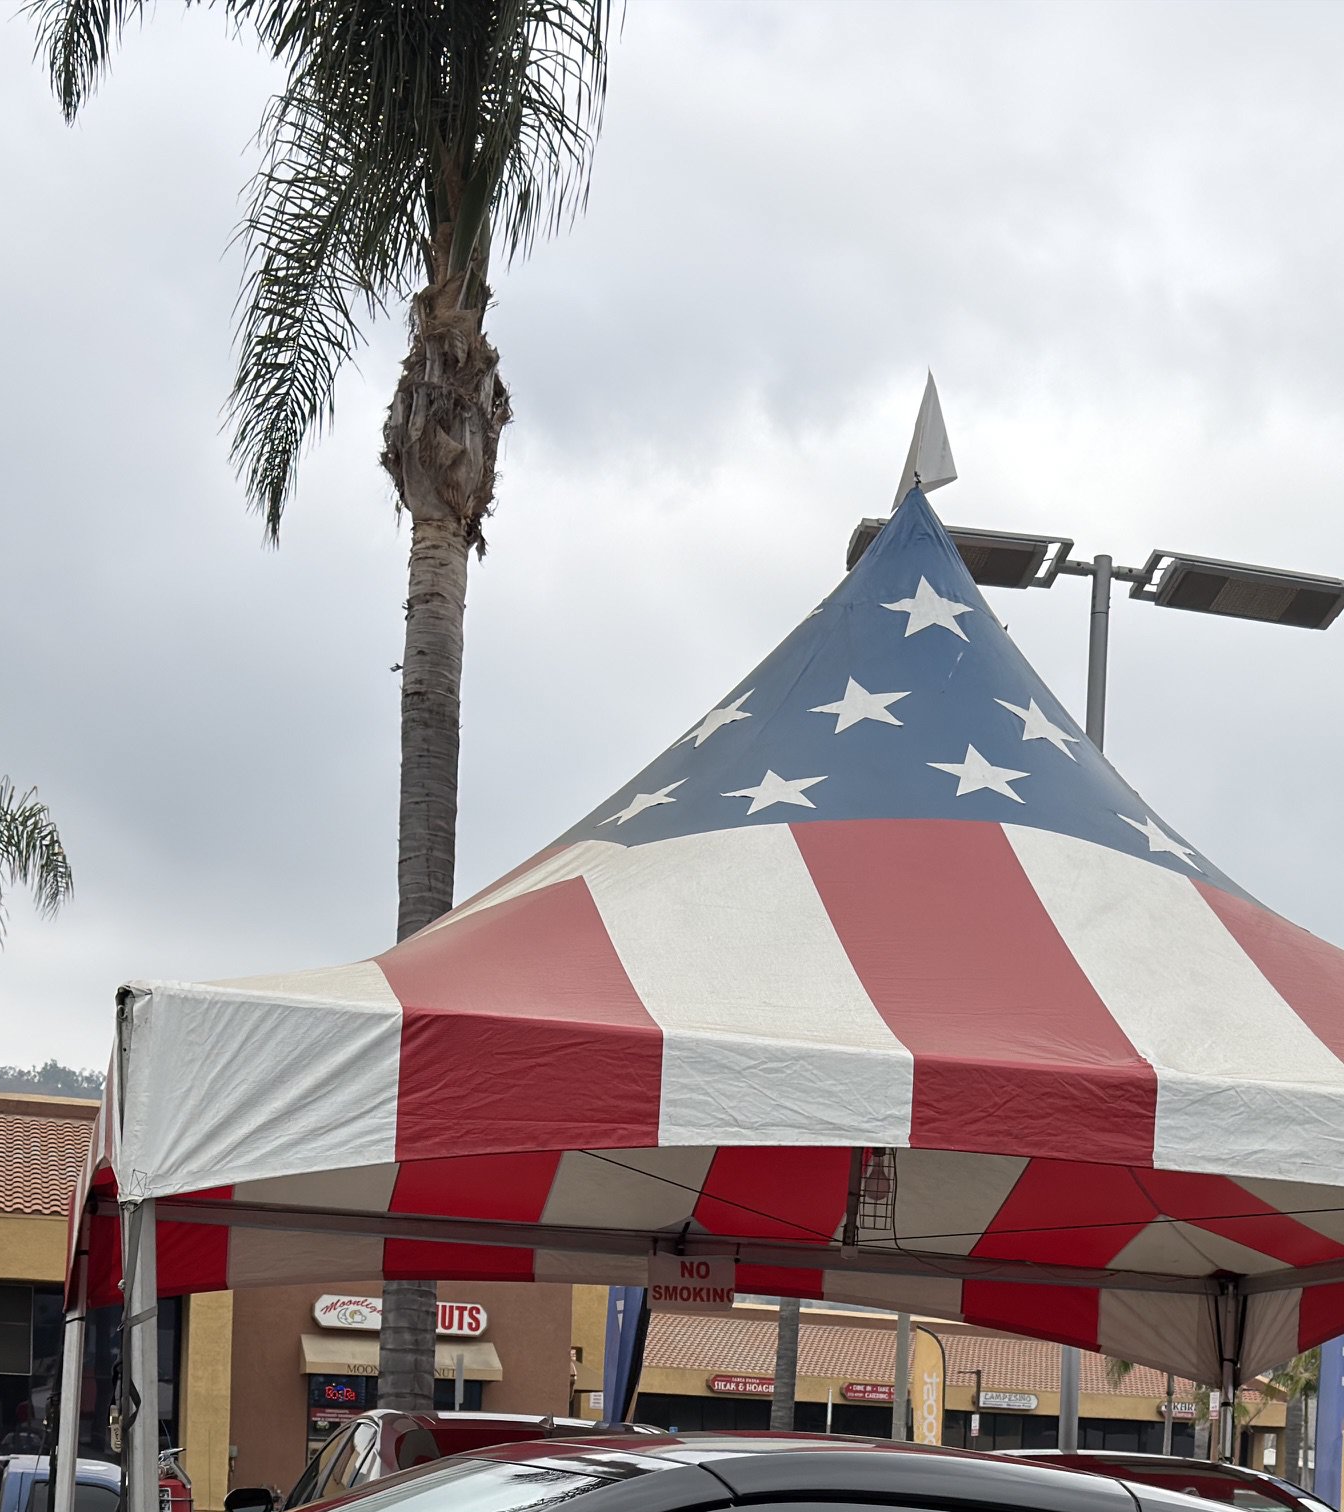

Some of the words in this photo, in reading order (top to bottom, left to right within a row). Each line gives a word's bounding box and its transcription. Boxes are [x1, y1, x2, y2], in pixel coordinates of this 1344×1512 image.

[680, 1260, 710, 1279] NO
[436, 1304, 481, 1332] UTS
[714, 1381, 737, 1390] STEAK
